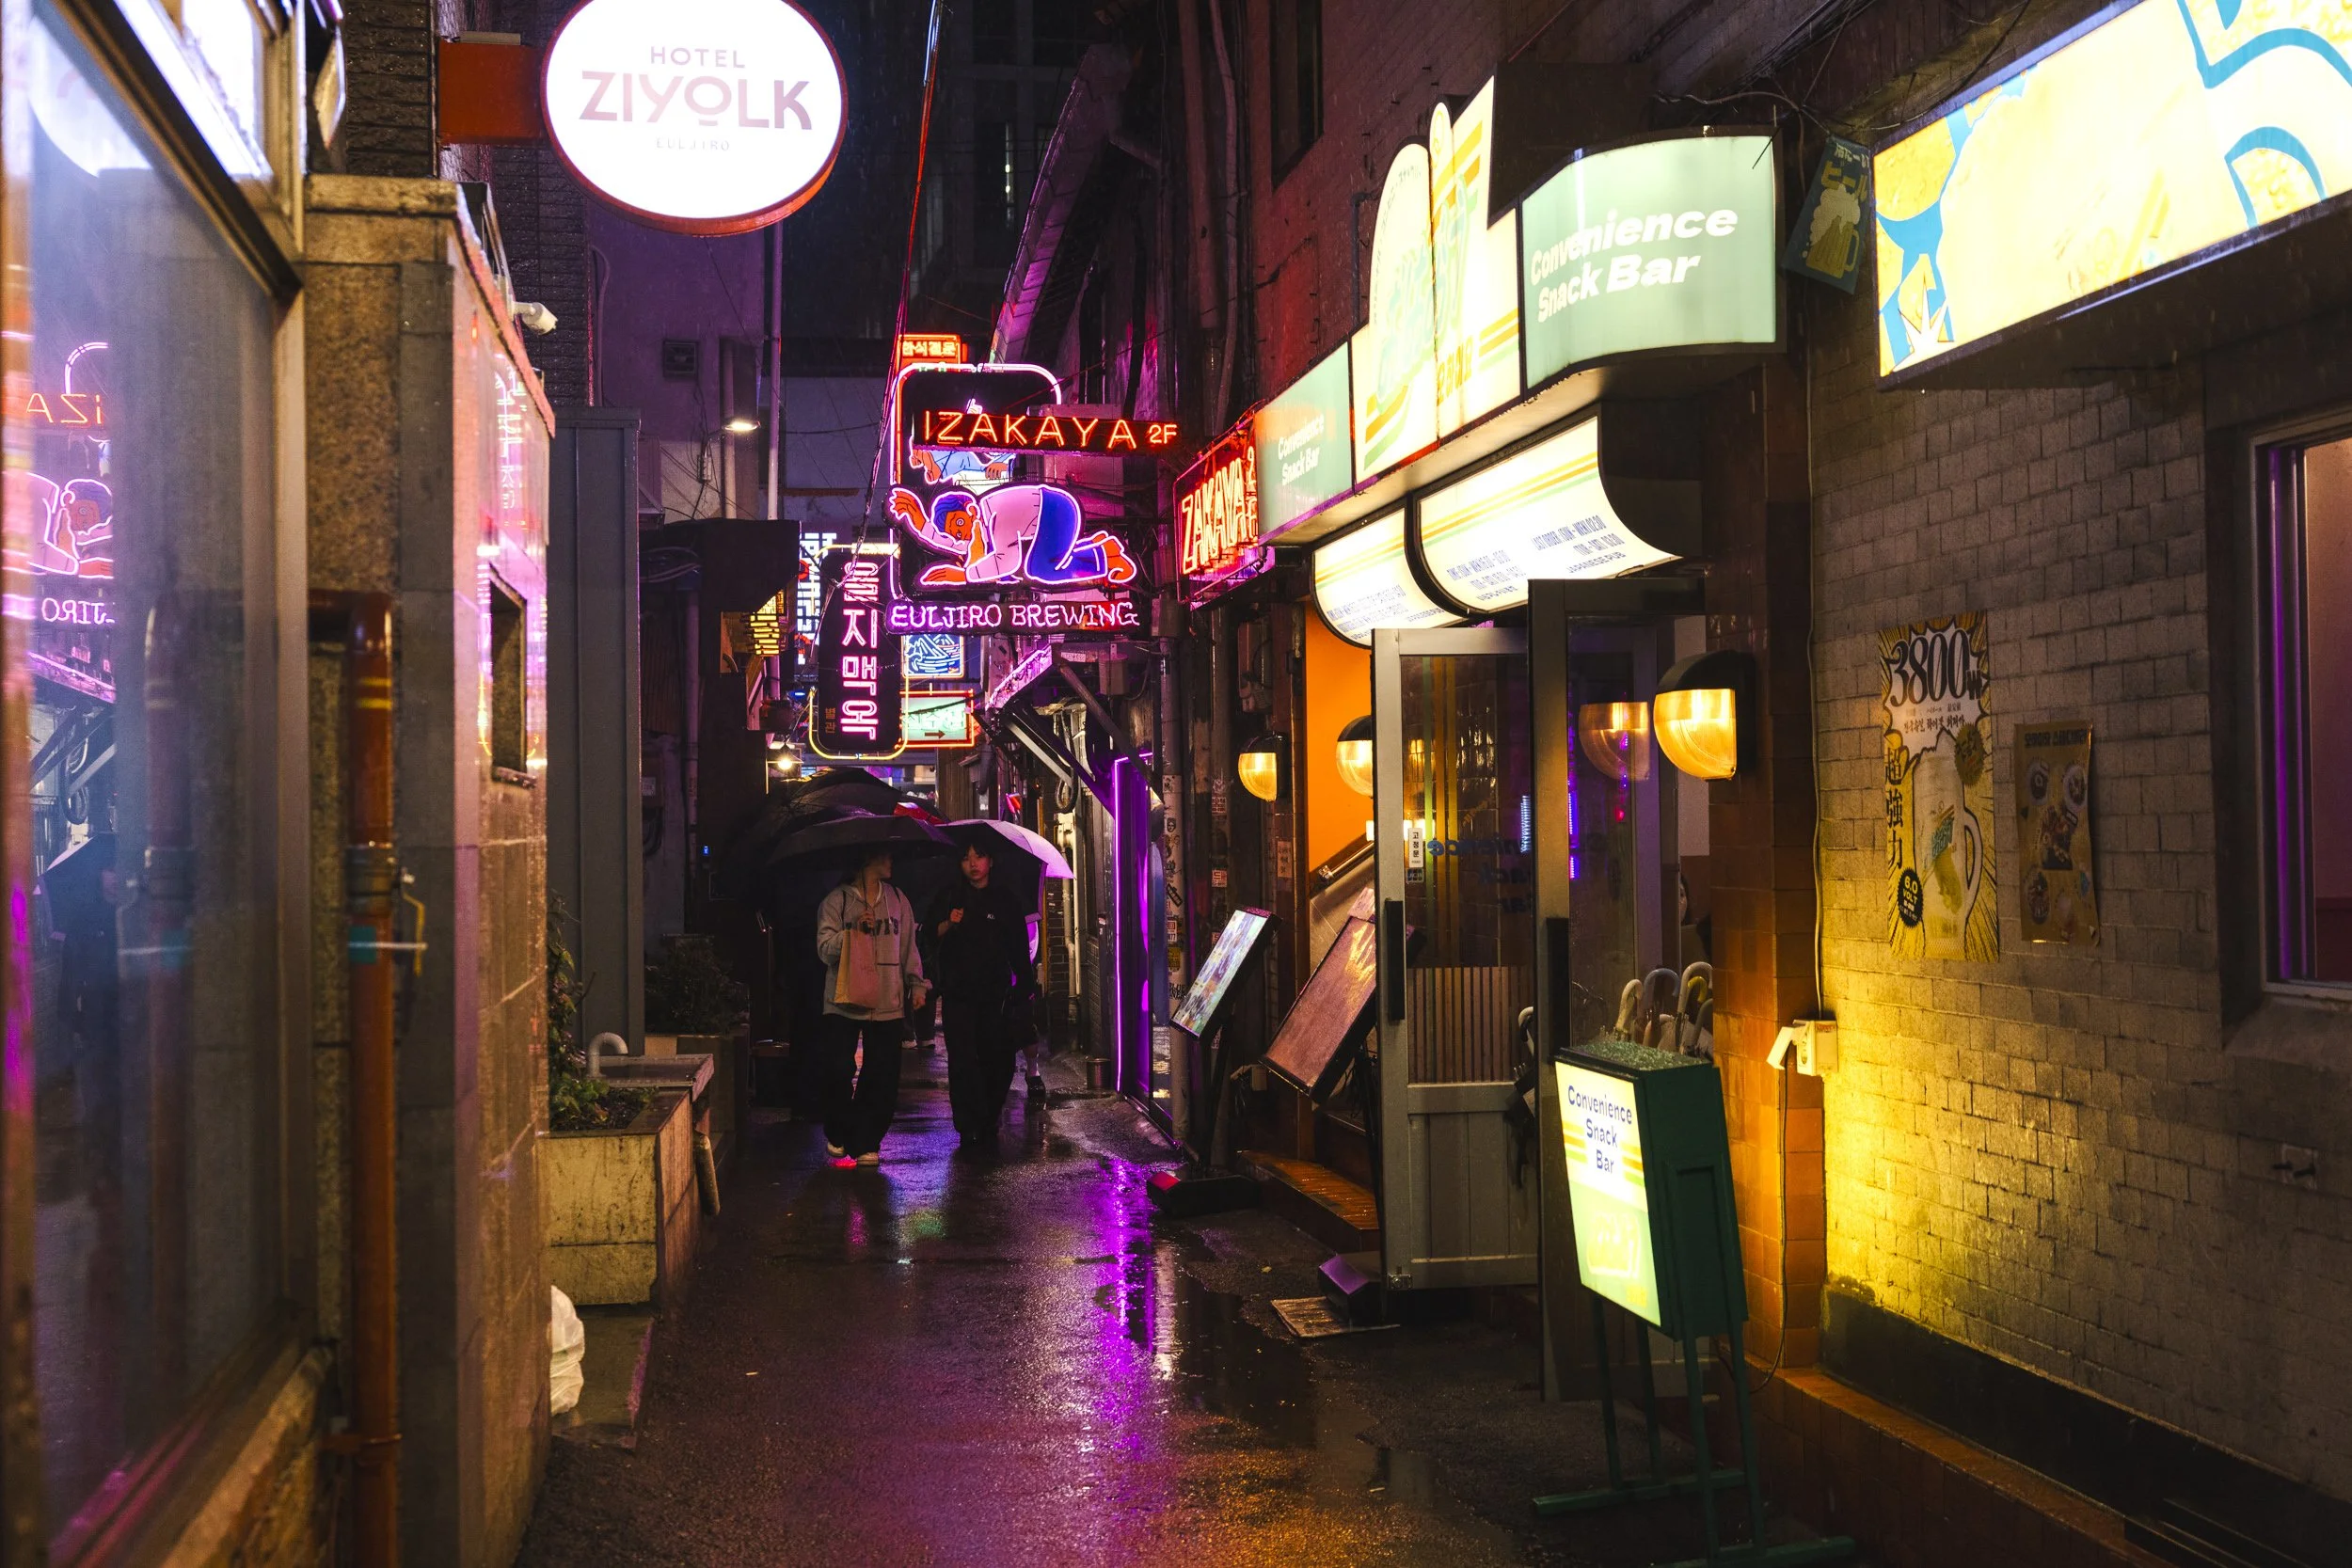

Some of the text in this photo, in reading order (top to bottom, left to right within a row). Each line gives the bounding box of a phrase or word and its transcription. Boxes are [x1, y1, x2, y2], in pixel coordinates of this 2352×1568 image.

[650, 45, 746, 70] HOTEL
[579, 71, 813, 130] ZIYOLK
[656, 137, 730, 152] EULJIRO
[1531, 209, 1739, 286] Convenience
[1537, 254, 1701, 324] Snack Bar
[925, 410, 1178, 450] IZAKAYA 2F
[1278, 414, 1325, 460] Convenience
[1281, 447, 1321, 486] Snack Bar
[890, 601, 1140, 628] EULJIRO BREWING
[840, 562, 881, 741] 을지맥옥
[1885, 746, 1903, 870] 超強力
[1903, 888, 1918, 905] VOLT
[1905, 876, 1918, 895] 6.0
[1567, 1084, 1632, 1125] Convenience
[1585, 1117, 1618, 1148] Snack
[1596, 1148, 1614, 1174] Bar
